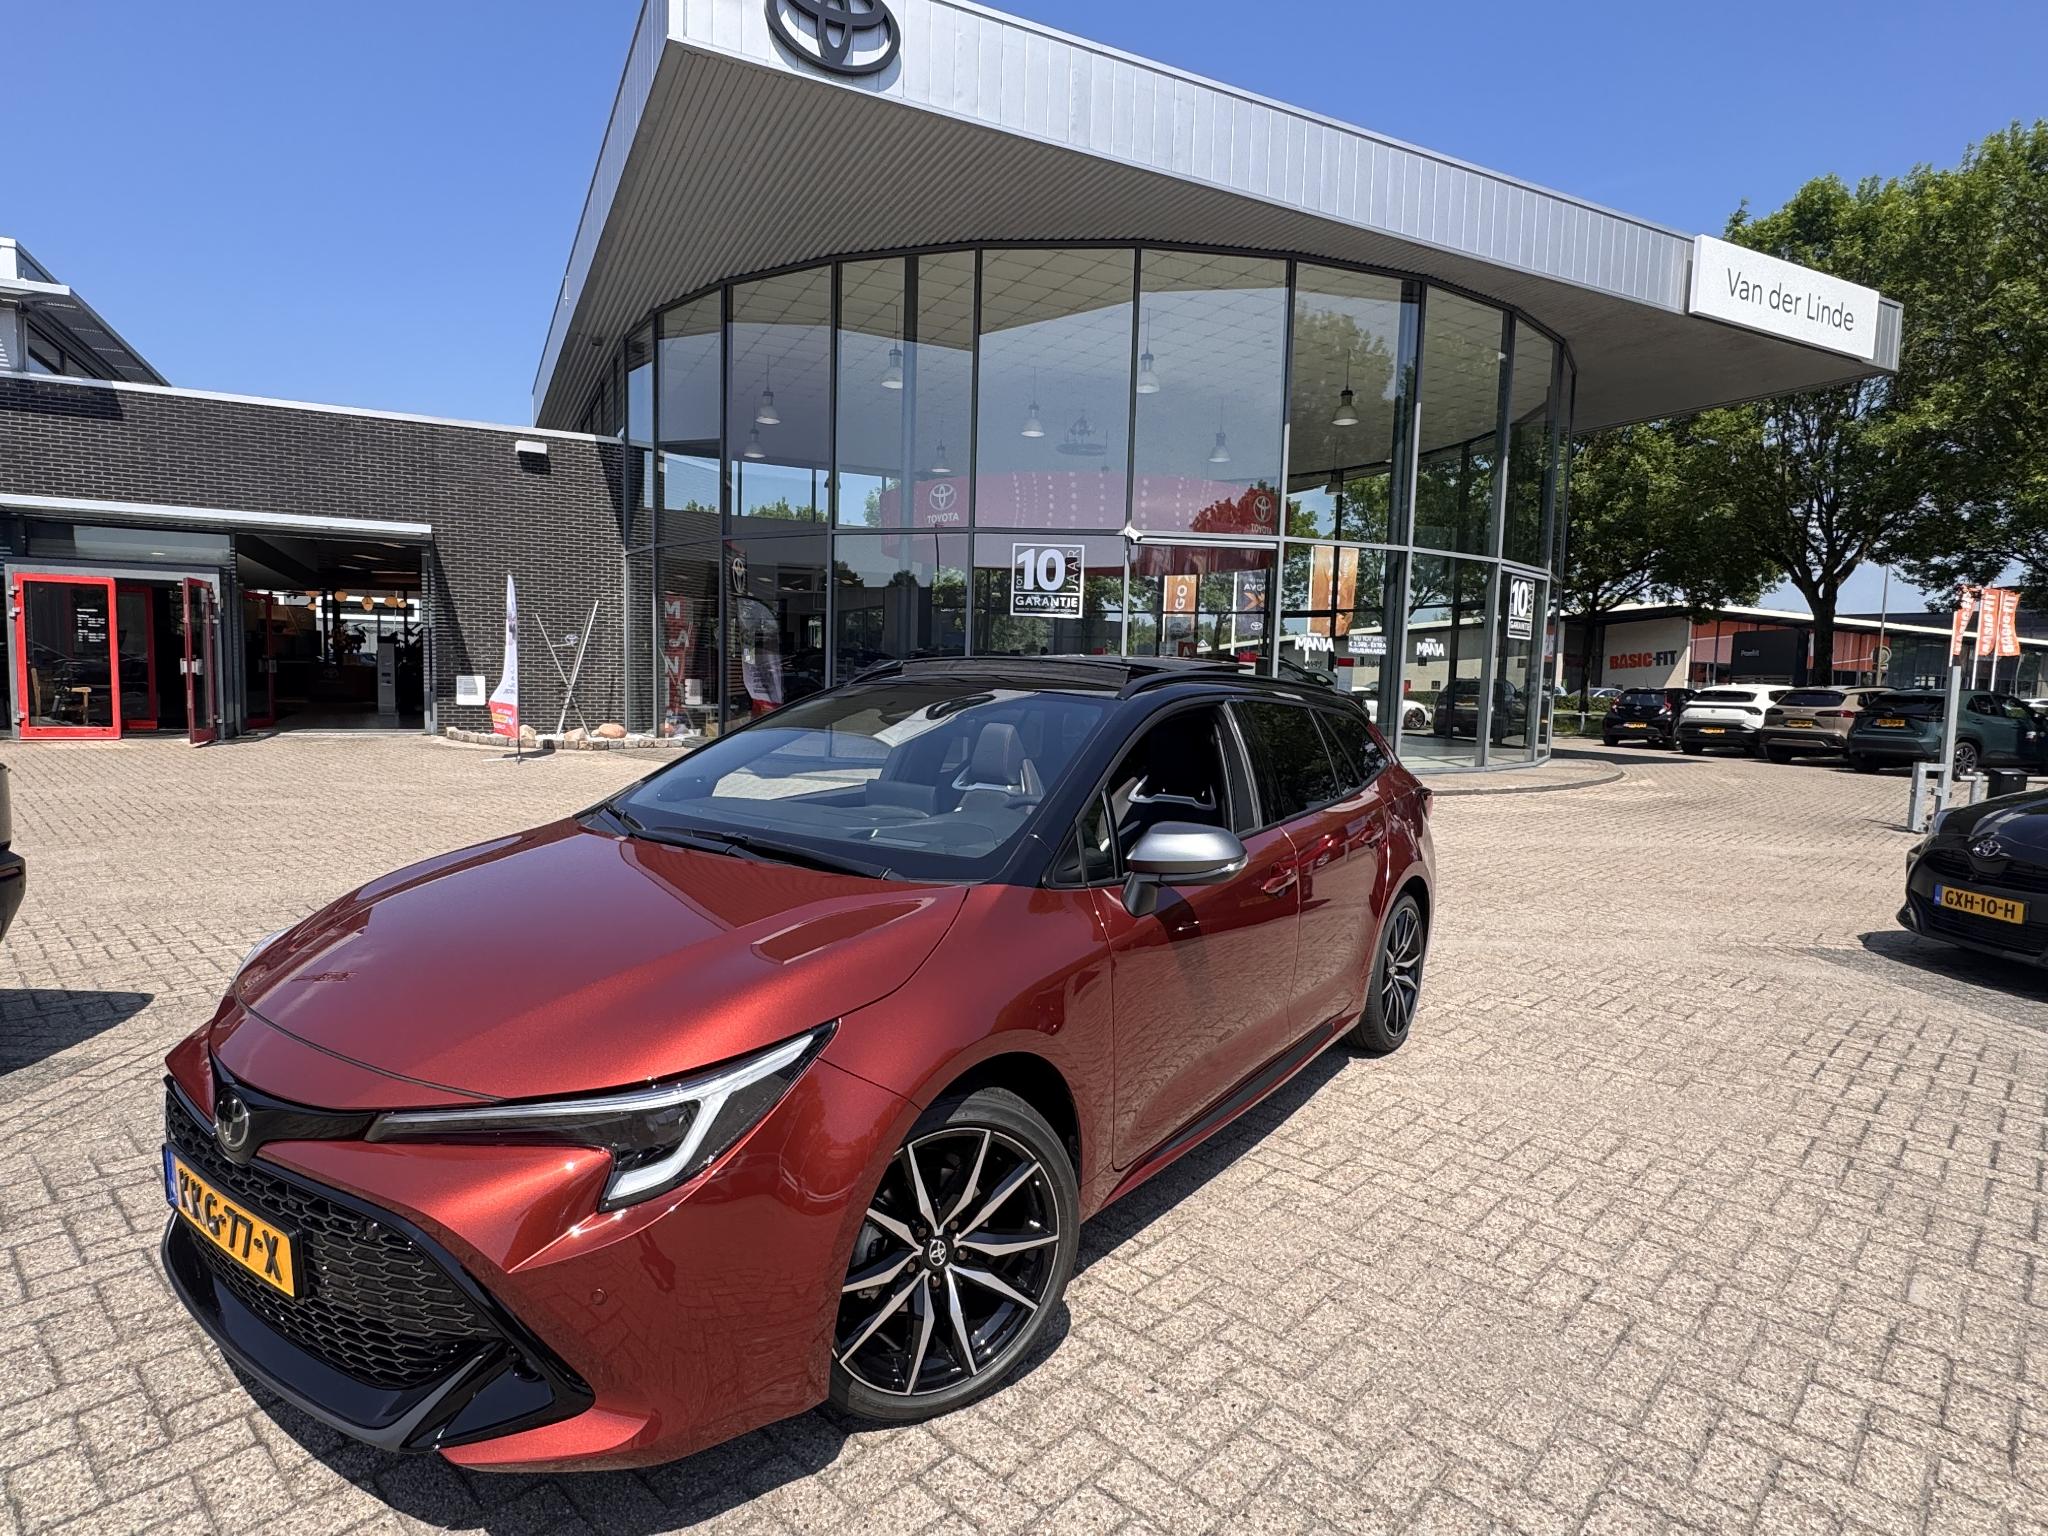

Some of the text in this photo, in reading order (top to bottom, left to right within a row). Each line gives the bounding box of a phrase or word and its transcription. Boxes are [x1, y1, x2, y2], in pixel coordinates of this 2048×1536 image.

[1727, 267, 1854, 331] Van der Linde
[927, 512, 959, 523] TOYOTA
[1017, 548, 1066, 591] 10
[1066, 550, 1080, 592] JAAR
[1244, 583, 1266, 592] AYG
[1015, 596, 1078, 608] GARANTIE
[1512, 580, 1529, 617] 10
[1294, 636, 1335, 652] MANIA
[1416, 642, 1445, 657] MANIA
[1609, 650, 1678, 670] BASIC-FIT
[1944, 889, 2016, 919] GXH-10-H
